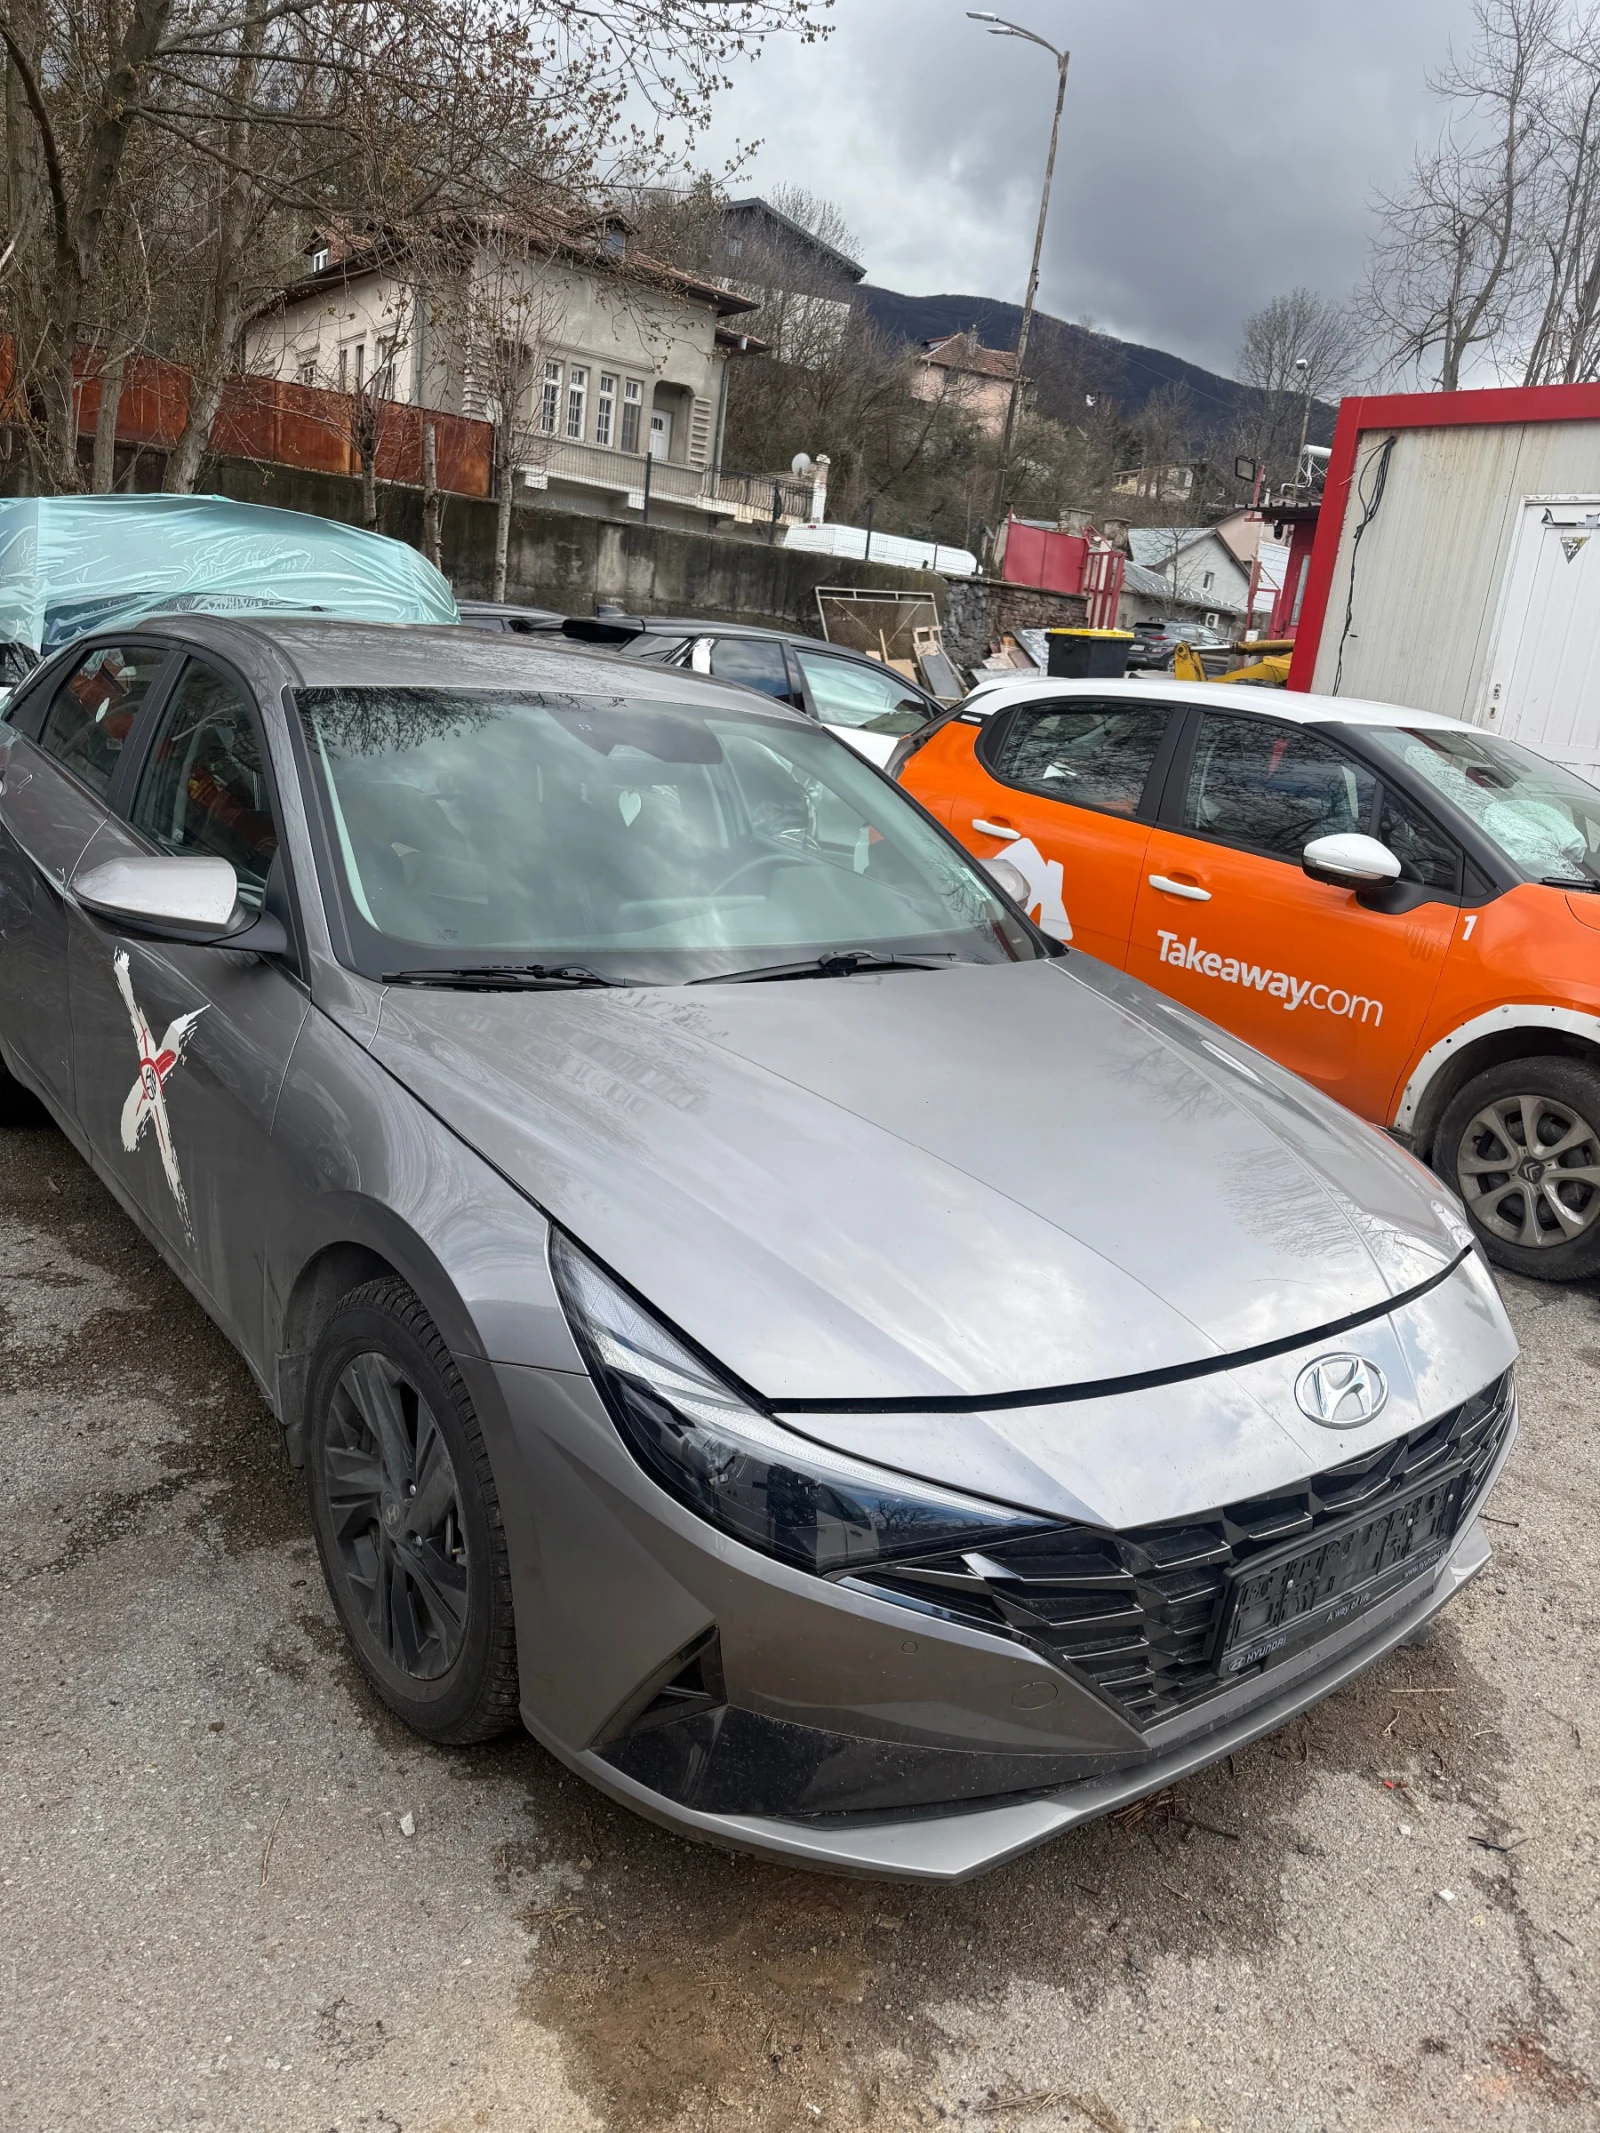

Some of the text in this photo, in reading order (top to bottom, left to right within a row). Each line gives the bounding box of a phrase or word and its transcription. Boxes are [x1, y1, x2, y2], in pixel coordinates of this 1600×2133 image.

[1462, 914, 1478, 941] 1
[1157, 929, 1383, 1027] Takeaway.com
[1247, 1635, 1287, 1663] HYUNDAI
